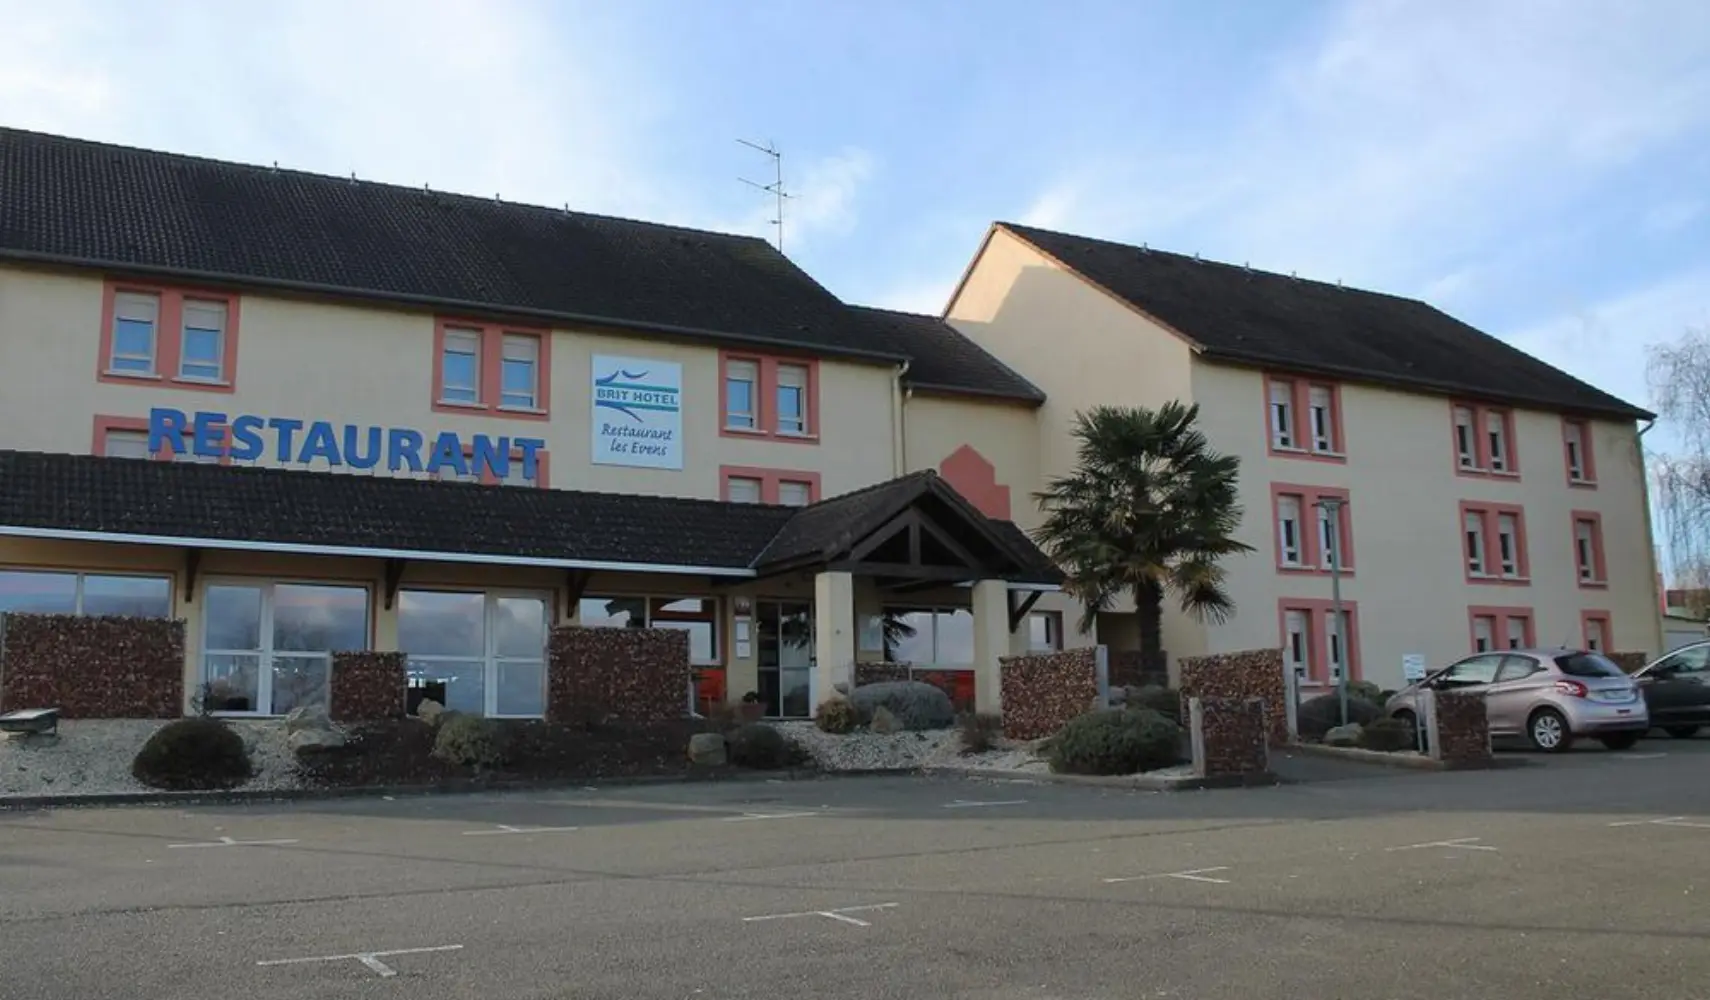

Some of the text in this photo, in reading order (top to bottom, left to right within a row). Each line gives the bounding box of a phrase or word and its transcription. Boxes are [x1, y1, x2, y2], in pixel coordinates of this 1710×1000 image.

[597, 388, 678, 405] BRIT HOTEL
[601, 423, 673, 440] Restaurant
[148, 407, 545, 480] RESTAURANT
[610, 438, 628, 453] les
